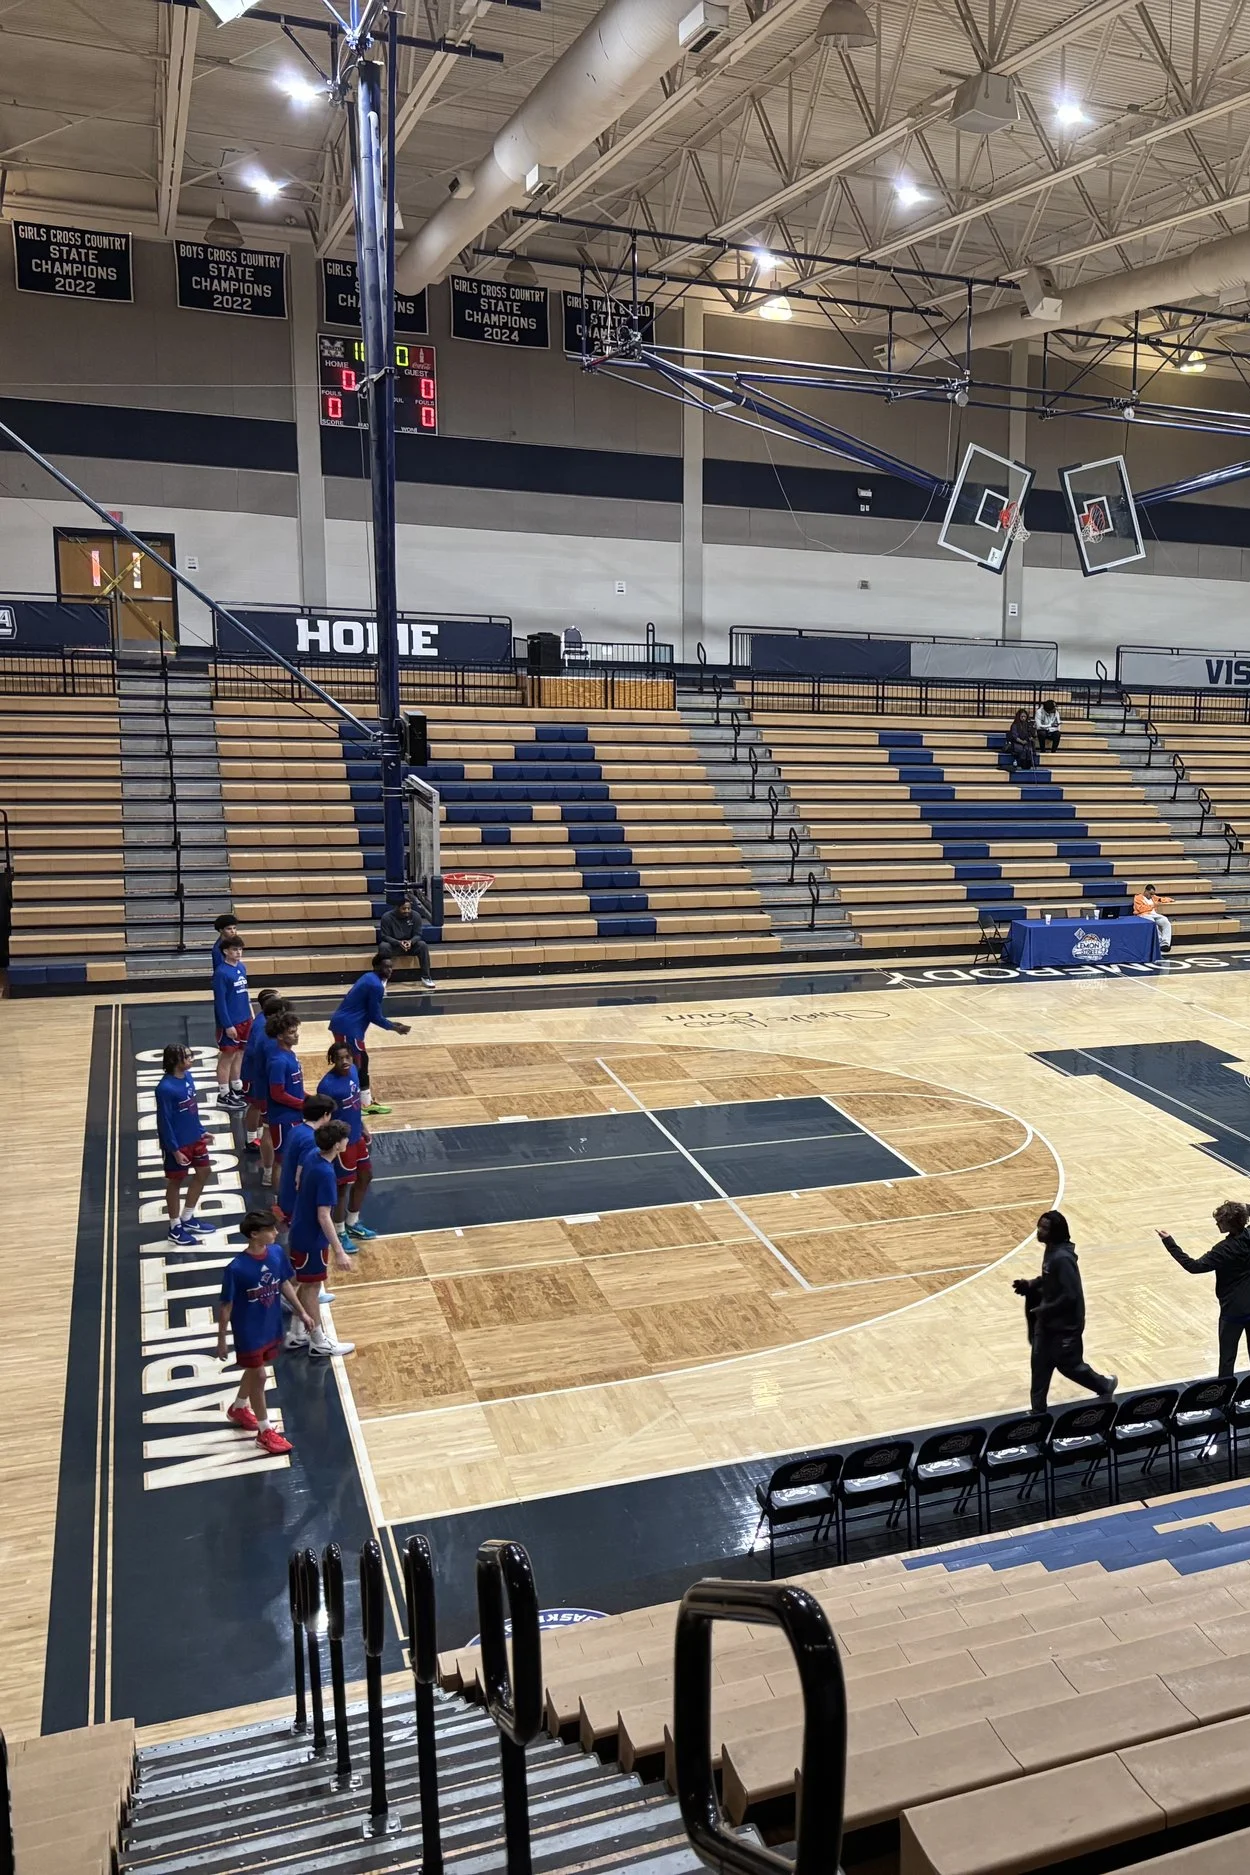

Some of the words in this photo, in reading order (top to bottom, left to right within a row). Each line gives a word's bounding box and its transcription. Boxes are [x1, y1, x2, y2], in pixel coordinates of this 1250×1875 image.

[18, 225, 47, 241] GIRLS
[50, 229, 81, 245] CROSS
[85, 233, 126, 251] COUNTRY
[49, 245, 98, 263] STATE
[180, 244, 204, 259] BOYS
[207, 247, 237, 263] CROSS
[240, 252, 281, 268] COUNTRY
[31, 259, 117, 281] CHAMPIONS
[208, 263, 254, 280] STATE
[326, 262, 352, 277] GIRLS
[55, 277, 96, 294] 2022
[191, 276, 272, 297] CHAMPIONS
[454, 279, 478, 294] GIRLS
[480, 284, 507, 299] CROSS
[510, 287, 545, 303] COUNTRY
[213, 294, 252, 311] 2022
[480, 298, 521, 314] STATE
[464, 309, 537, 330] CHAMPIONS
[484, 327, 519, 342] 2024
[324, 360, 349, 369] HOME
[404, 368, 429, 378] GUEST
[342, 370, 355, 391] 0
[421, 378, 434, 399] 0
[321, 389, 342, 397] FOULS
[328, 397, 342, 418] 0
[422, 407, 435, 427] 0
[662, 1011, 754, 1022] Court
[140, 1222, 292, 1492] MARIETTA
